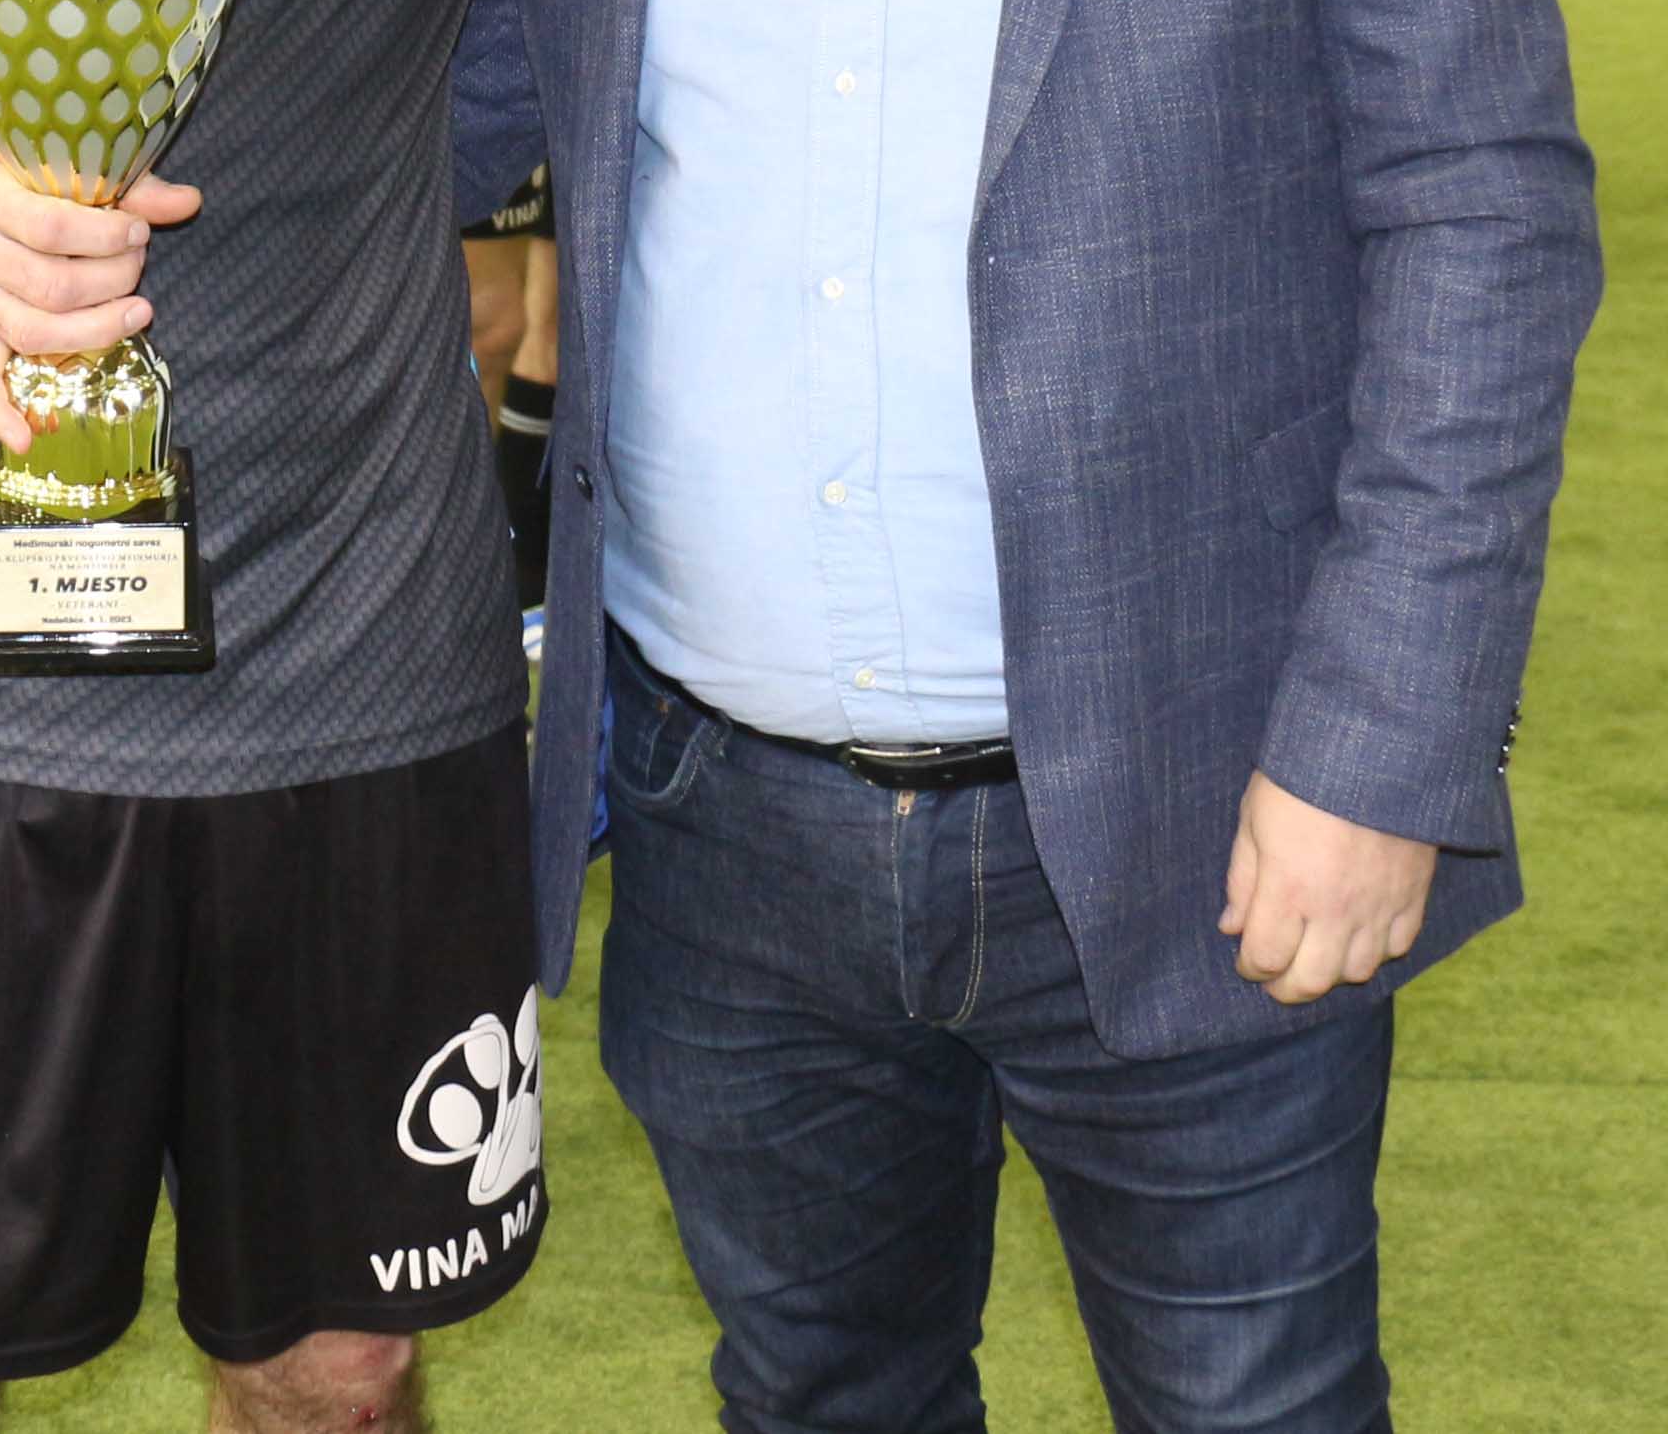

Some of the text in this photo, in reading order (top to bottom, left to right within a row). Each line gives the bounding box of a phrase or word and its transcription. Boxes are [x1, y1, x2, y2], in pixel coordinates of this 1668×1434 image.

[29, 576, 147, 594] 1. MJESTO
[370, 1226, 489, 1293] VINA
